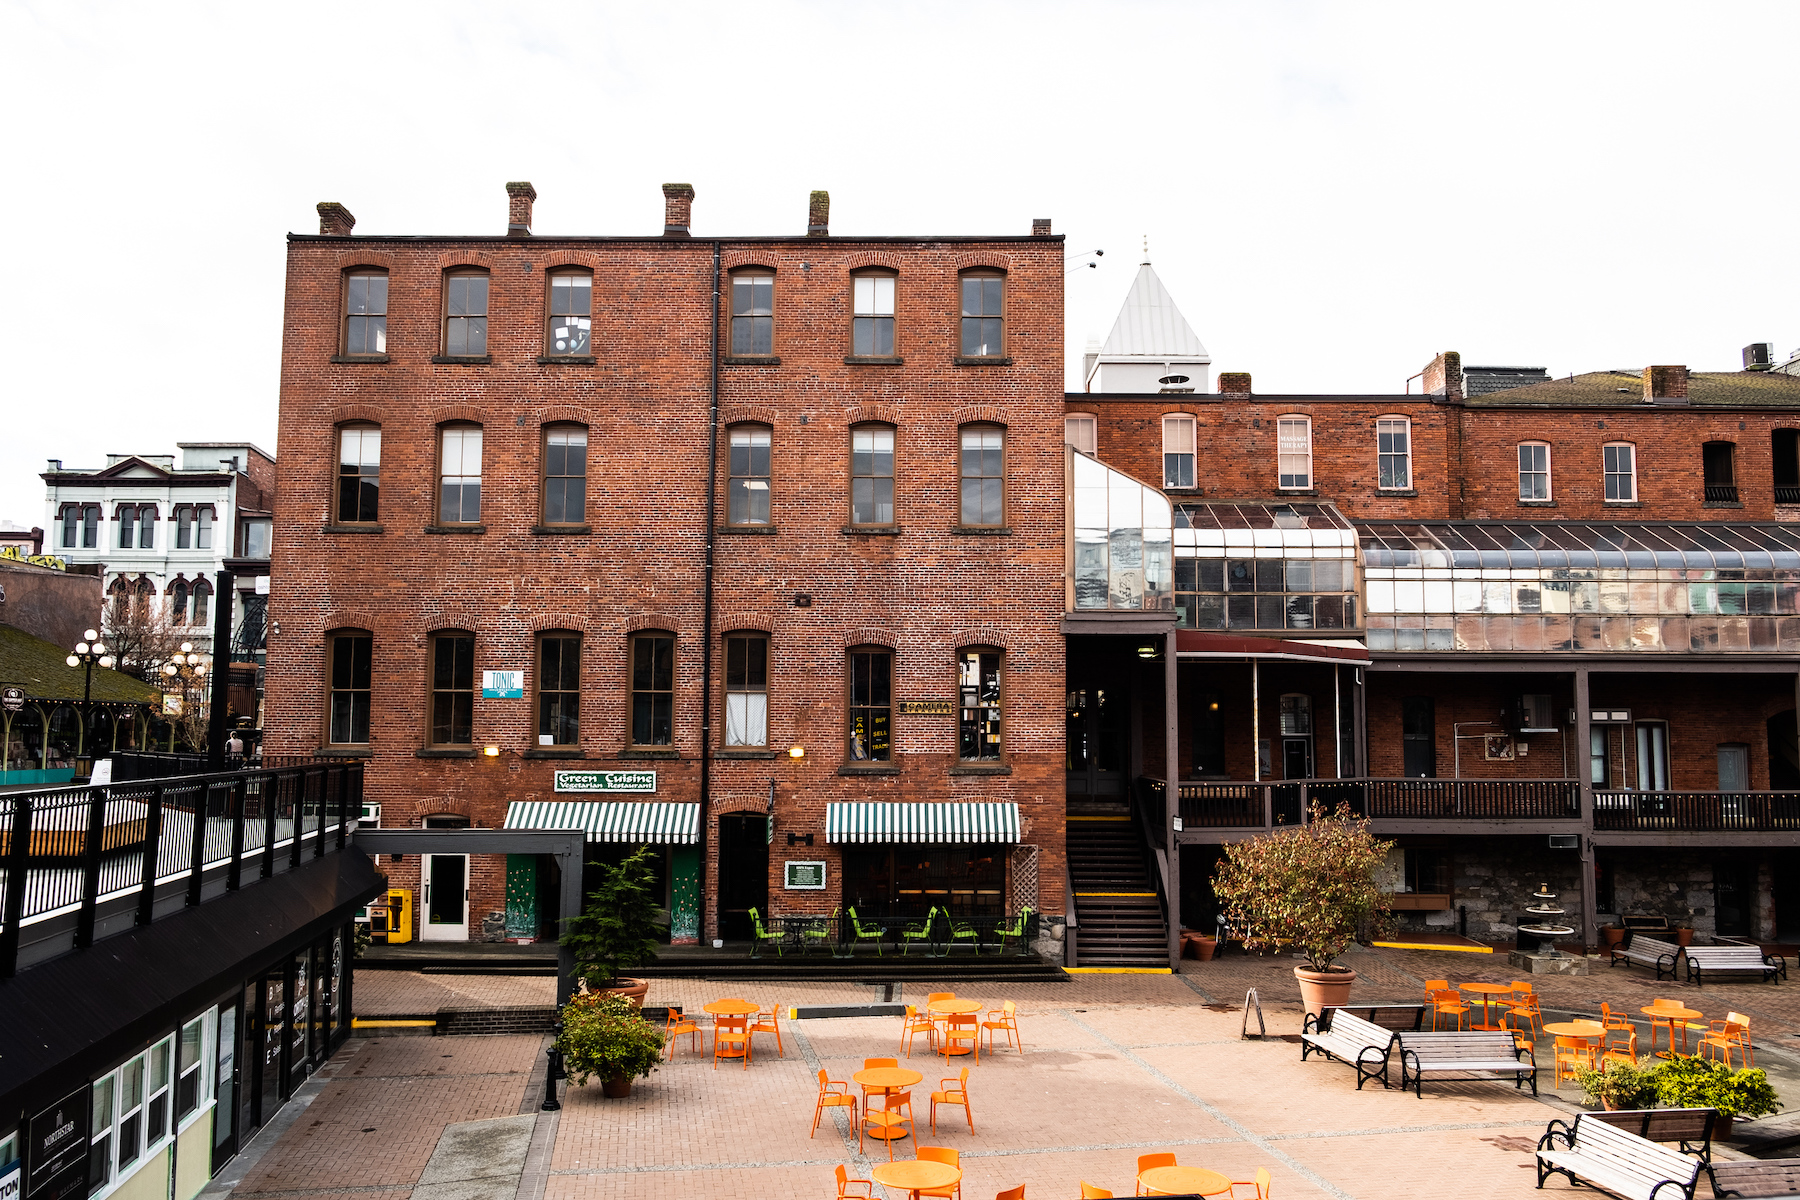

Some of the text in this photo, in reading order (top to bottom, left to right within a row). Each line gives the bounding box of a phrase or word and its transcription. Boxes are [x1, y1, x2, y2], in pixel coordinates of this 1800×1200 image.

[492, 672, 515, 689] TONIC
[856, 716, 864, 759] CAMERA
[559, 773, 653, 783] Green Cuisine
[560, 782, 603, 790] Vegetarian
[43, 1120, 75, 1149] NORTHSTAR
